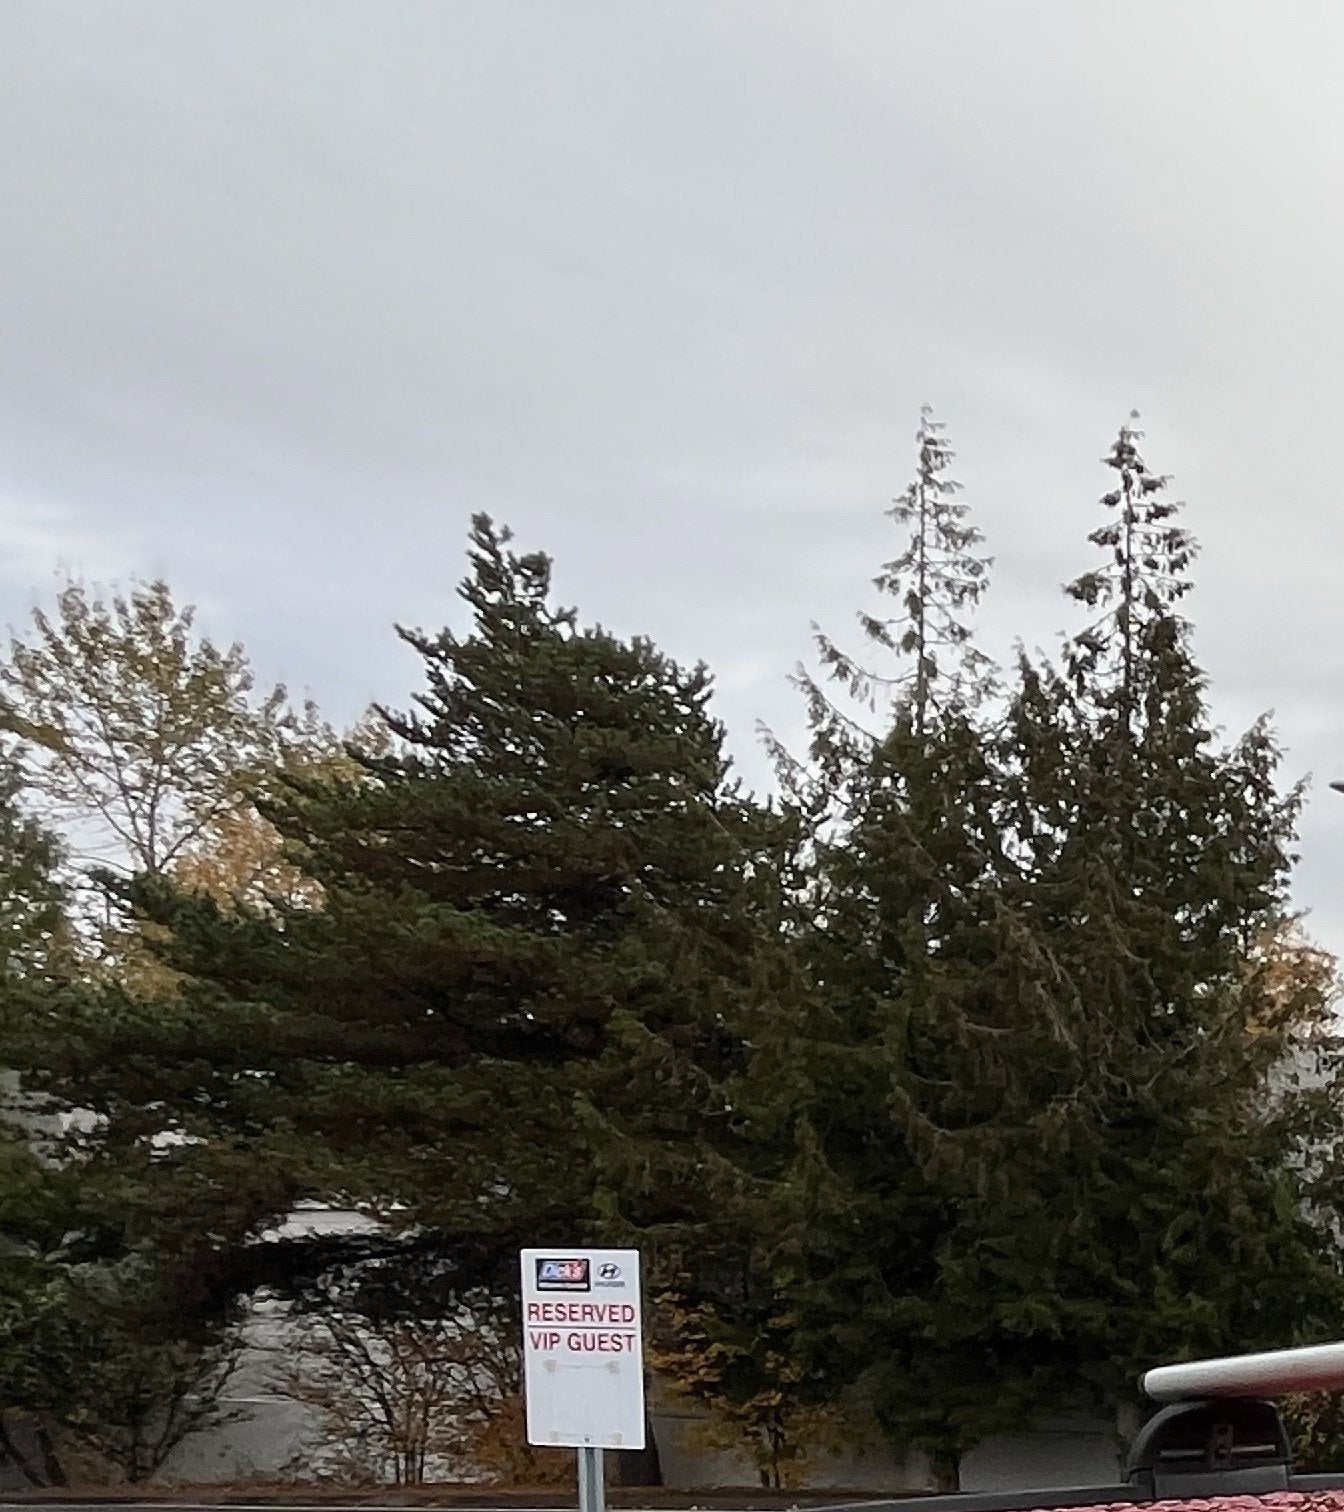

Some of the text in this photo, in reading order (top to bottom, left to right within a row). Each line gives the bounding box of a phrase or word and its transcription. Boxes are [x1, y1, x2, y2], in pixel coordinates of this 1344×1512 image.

[528, 1303, 635, 1322] RESERVED
[530, 1333, 636, 1351] VIP GUEST
